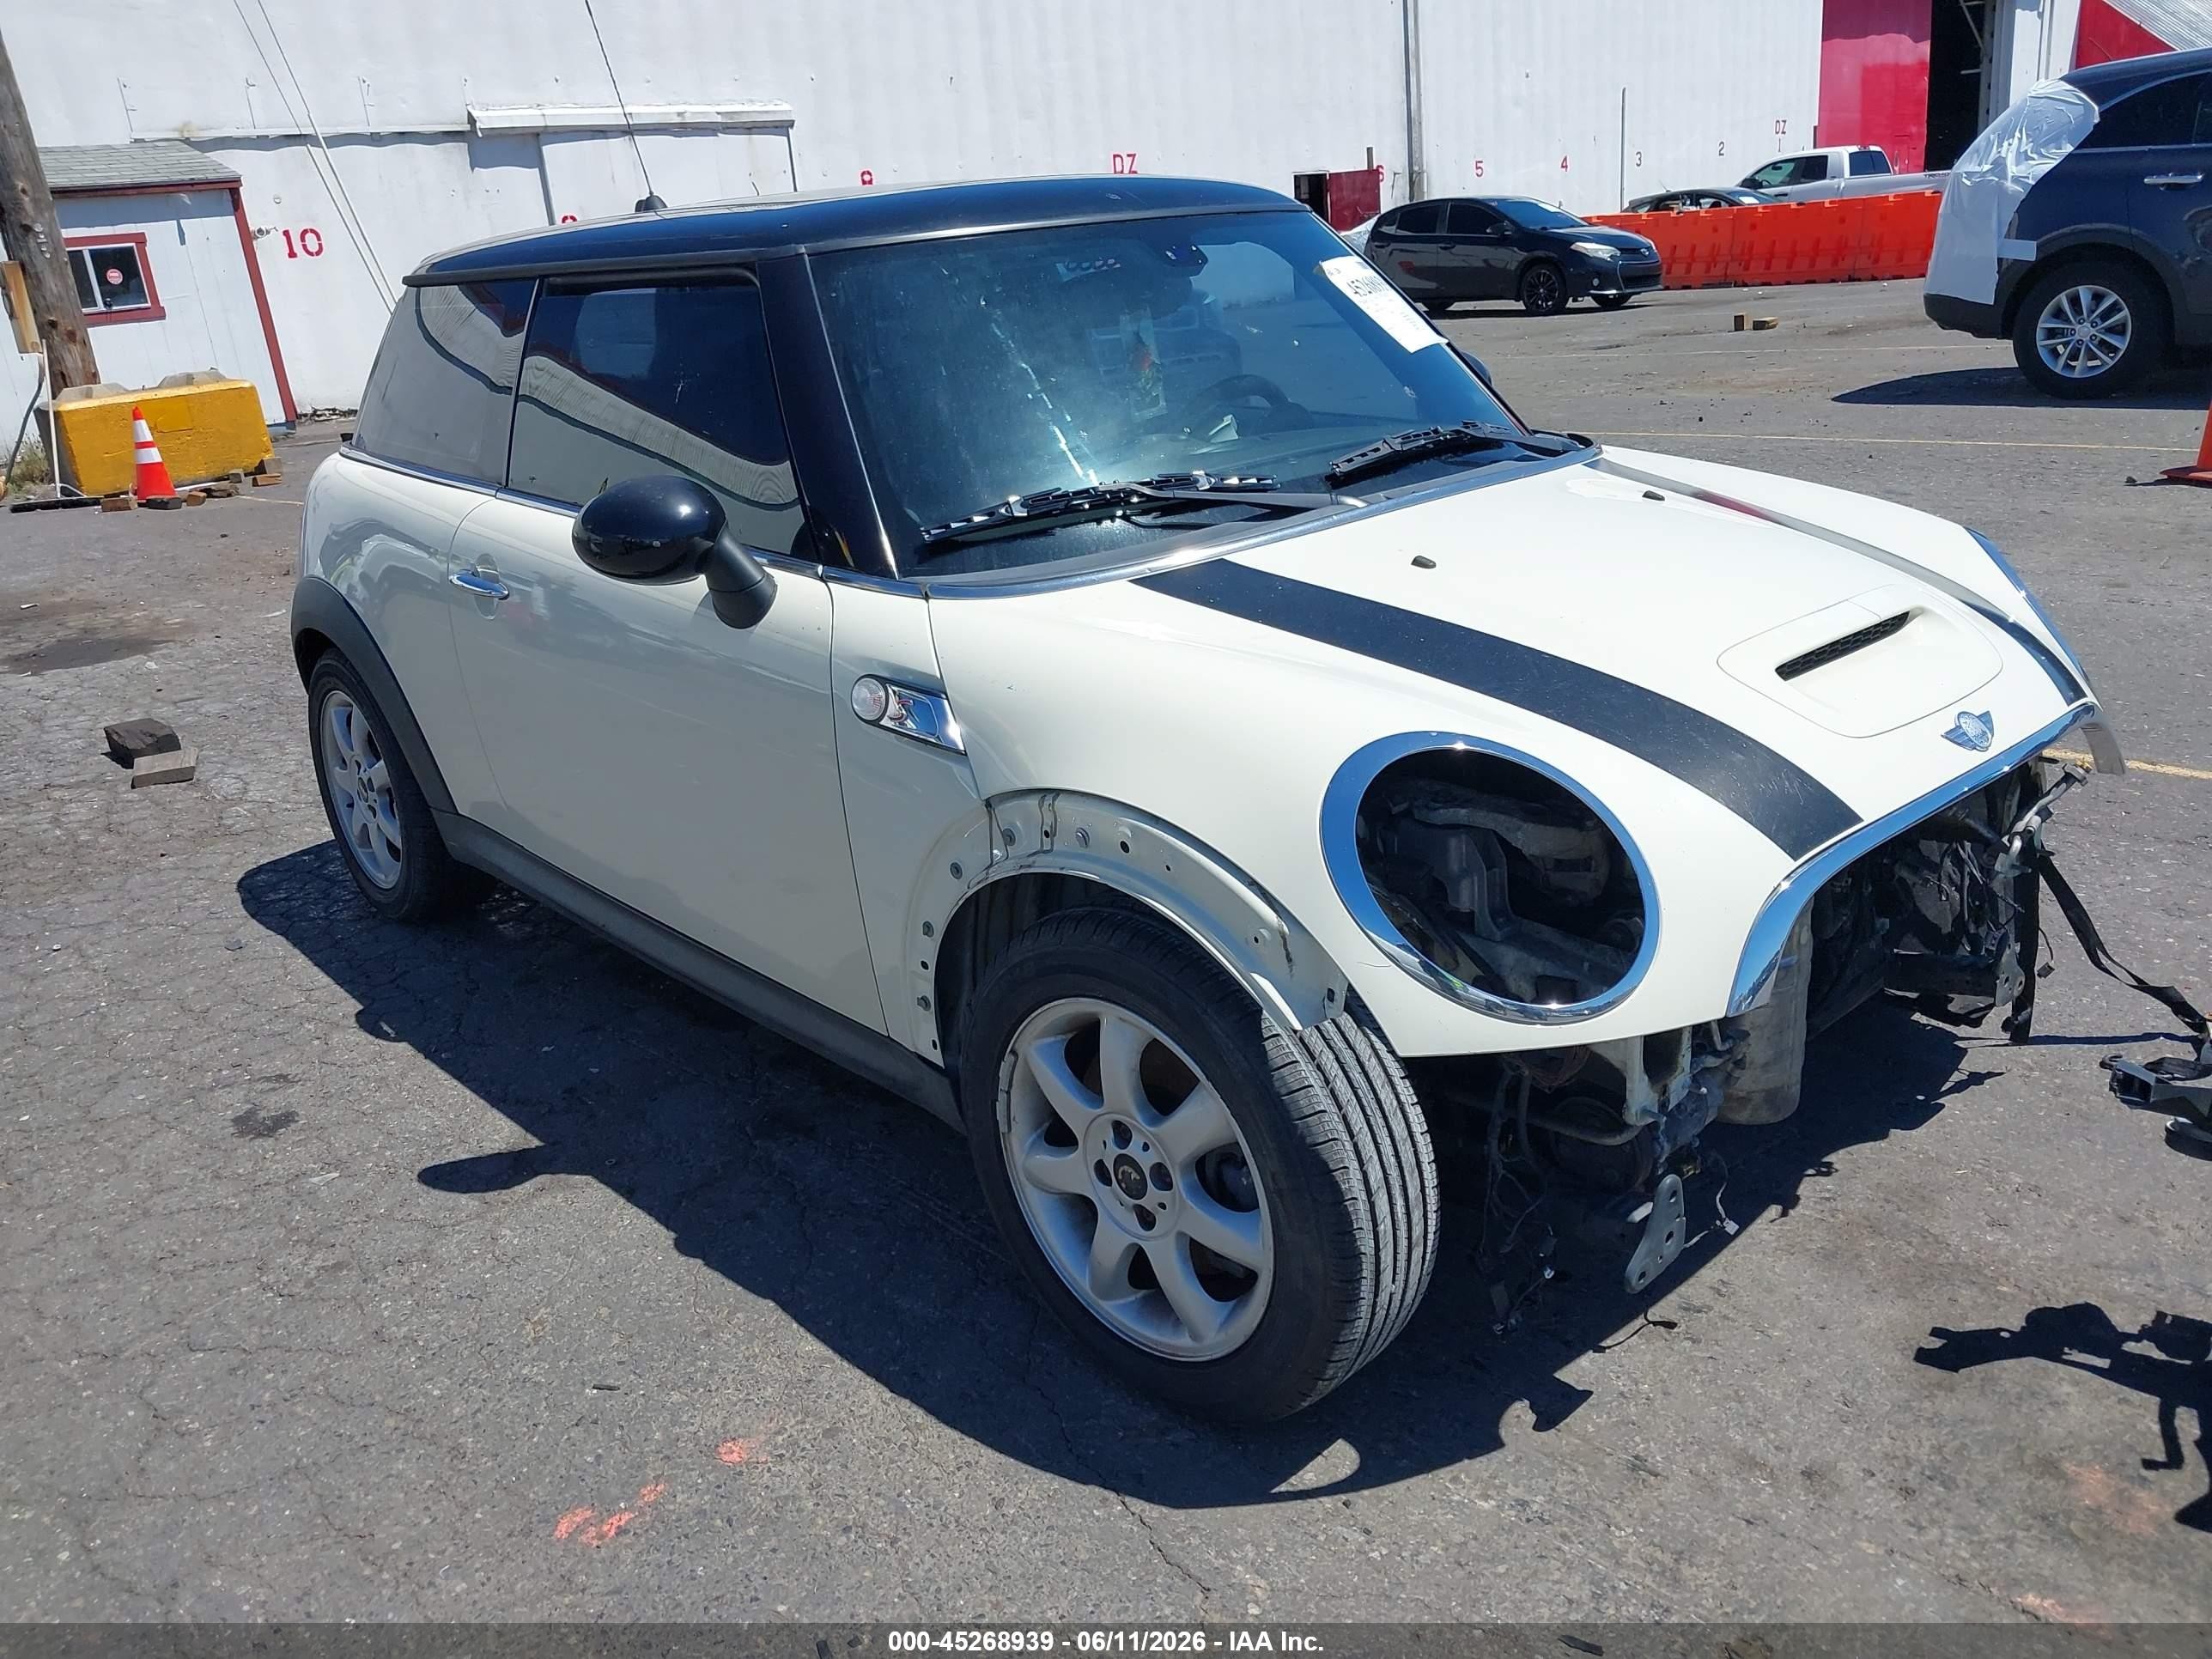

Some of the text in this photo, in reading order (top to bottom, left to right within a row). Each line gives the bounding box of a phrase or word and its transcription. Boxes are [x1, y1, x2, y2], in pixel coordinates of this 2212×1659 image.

[1718, 142, 1725, 155] 2
[1112, 153, 1138, 174] DZ
[1560, 155, 1568, 172] 4
[1635, 151, 1642, 167] 3
[1376, 165, 1384, 182] 6
[1474, 160, 1483, 177] 5
[283, 228, 323, 258] 10
